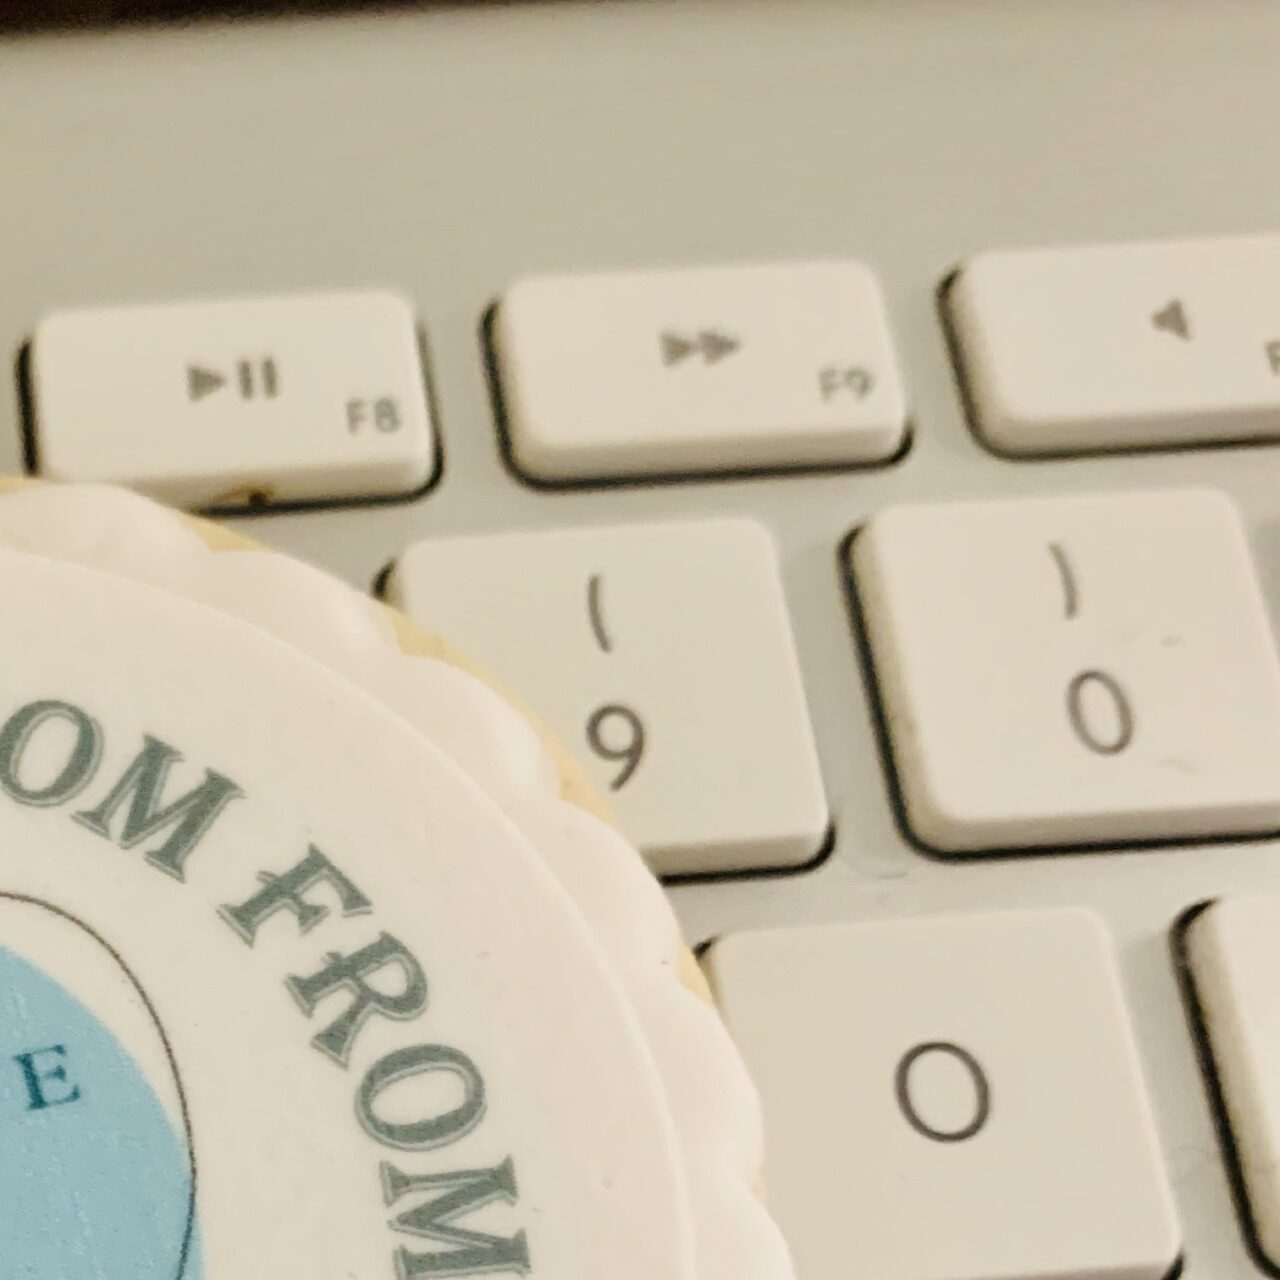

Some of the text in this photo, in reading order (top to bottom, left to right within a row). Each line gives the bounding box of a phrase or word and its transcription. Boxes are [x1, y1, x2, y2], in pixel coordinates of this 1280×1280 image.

[817, 364, 878, 403] F9
[344, 397, 402, 435] F8
[585, 703, 646, 792] 9
